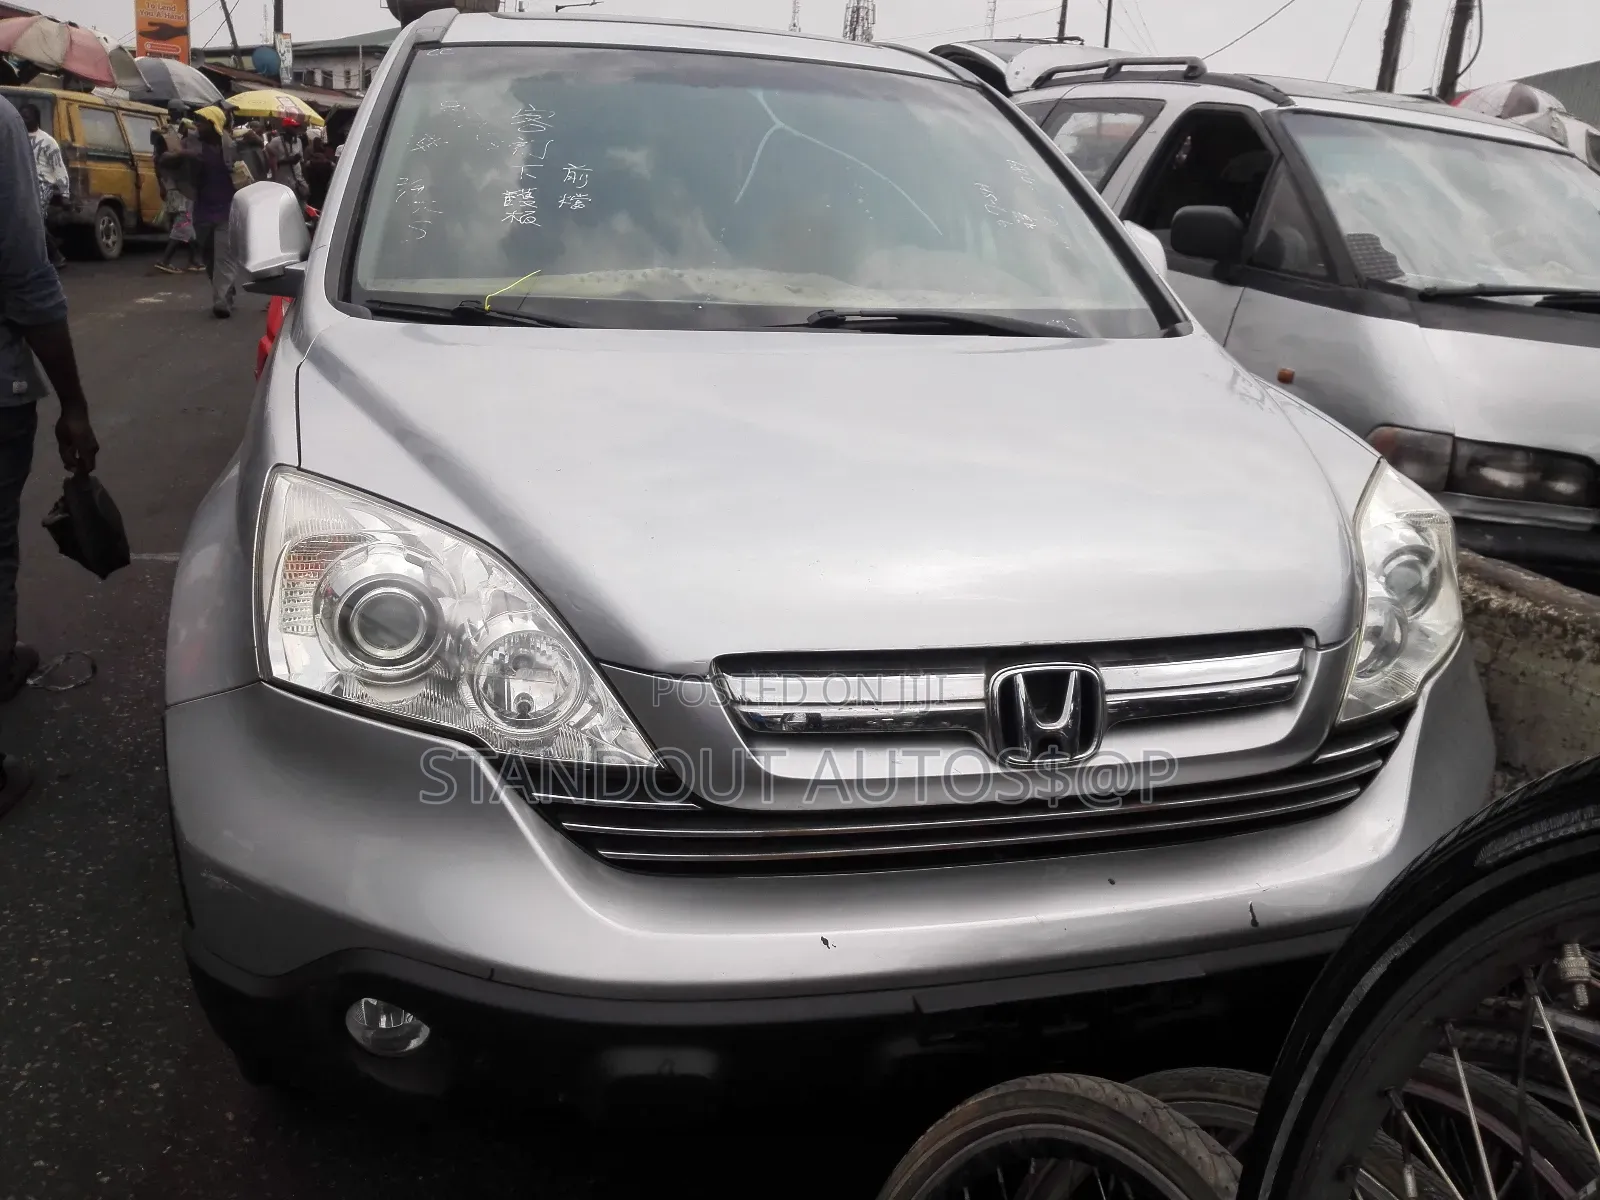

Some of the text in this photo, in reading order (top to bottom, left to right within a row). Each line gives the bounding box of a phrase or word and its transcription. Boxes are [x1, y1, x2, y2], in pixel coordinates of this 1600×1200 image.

[158, 4, 176, 12] Lend
[139, 9, 155, 17] You
[164, 12, 185, 20] Hand
